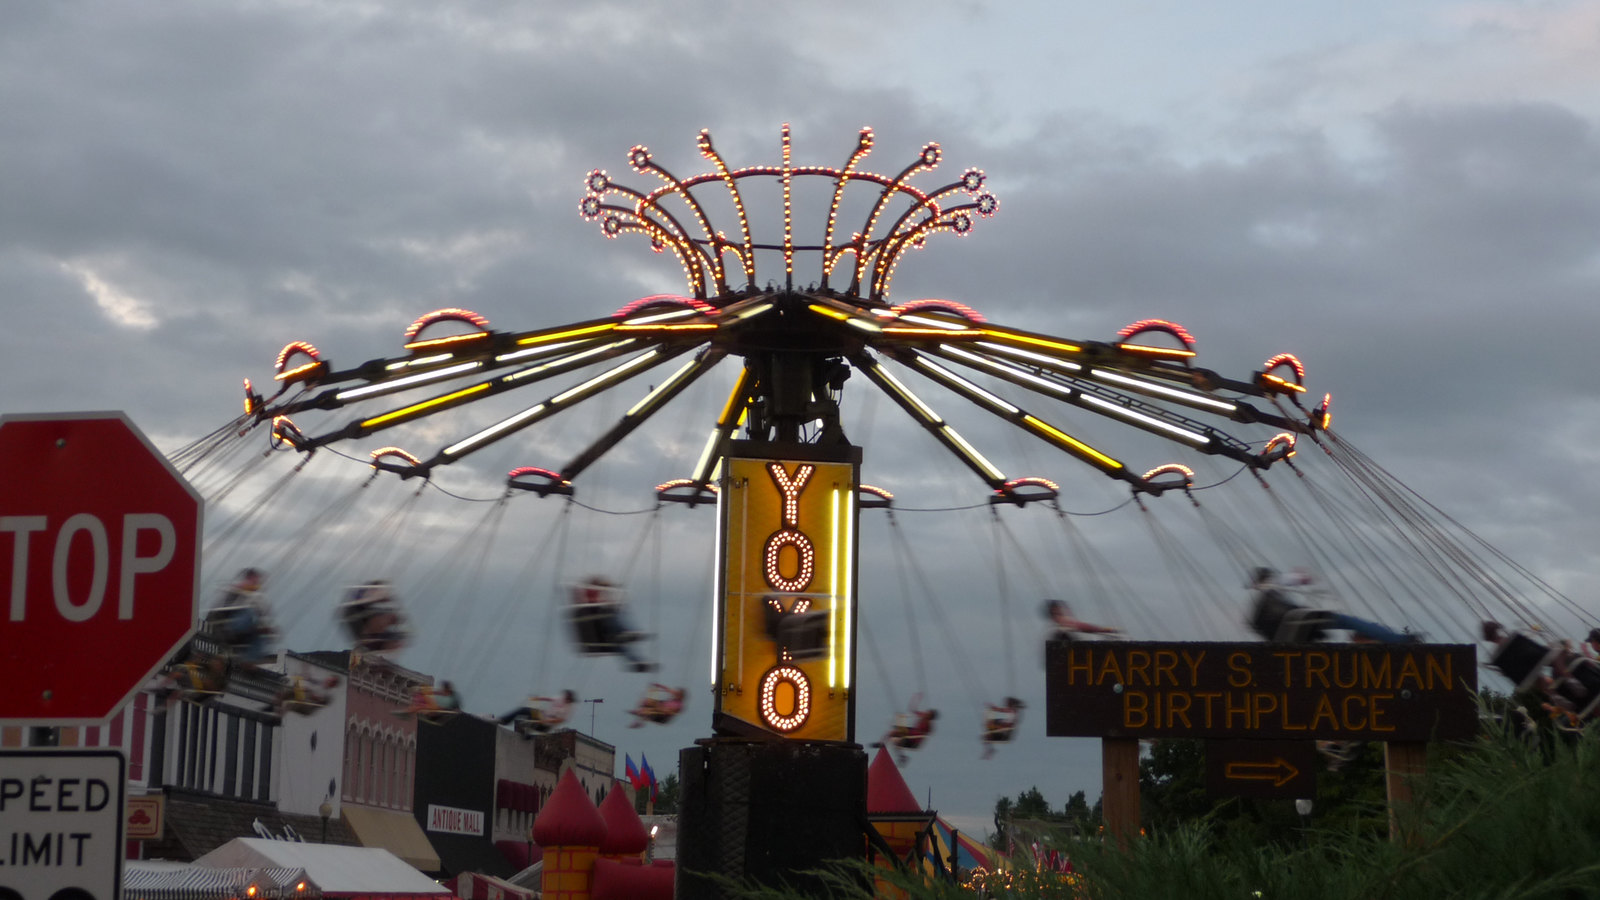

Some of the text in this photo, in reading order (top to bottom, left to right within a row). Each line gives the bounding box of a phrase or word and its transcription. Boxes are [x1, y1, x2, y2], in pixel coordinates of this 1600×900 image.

[1068, 650, 1206, 686] HARRY
[1273, 652, 1454, 690] TRUMAN
[1123, 691, 1396, 731] BIRTHPLACE
[433, 808, 480, 833] ANTIQUE MALL
[0, 832, 92, 867] IMIT
